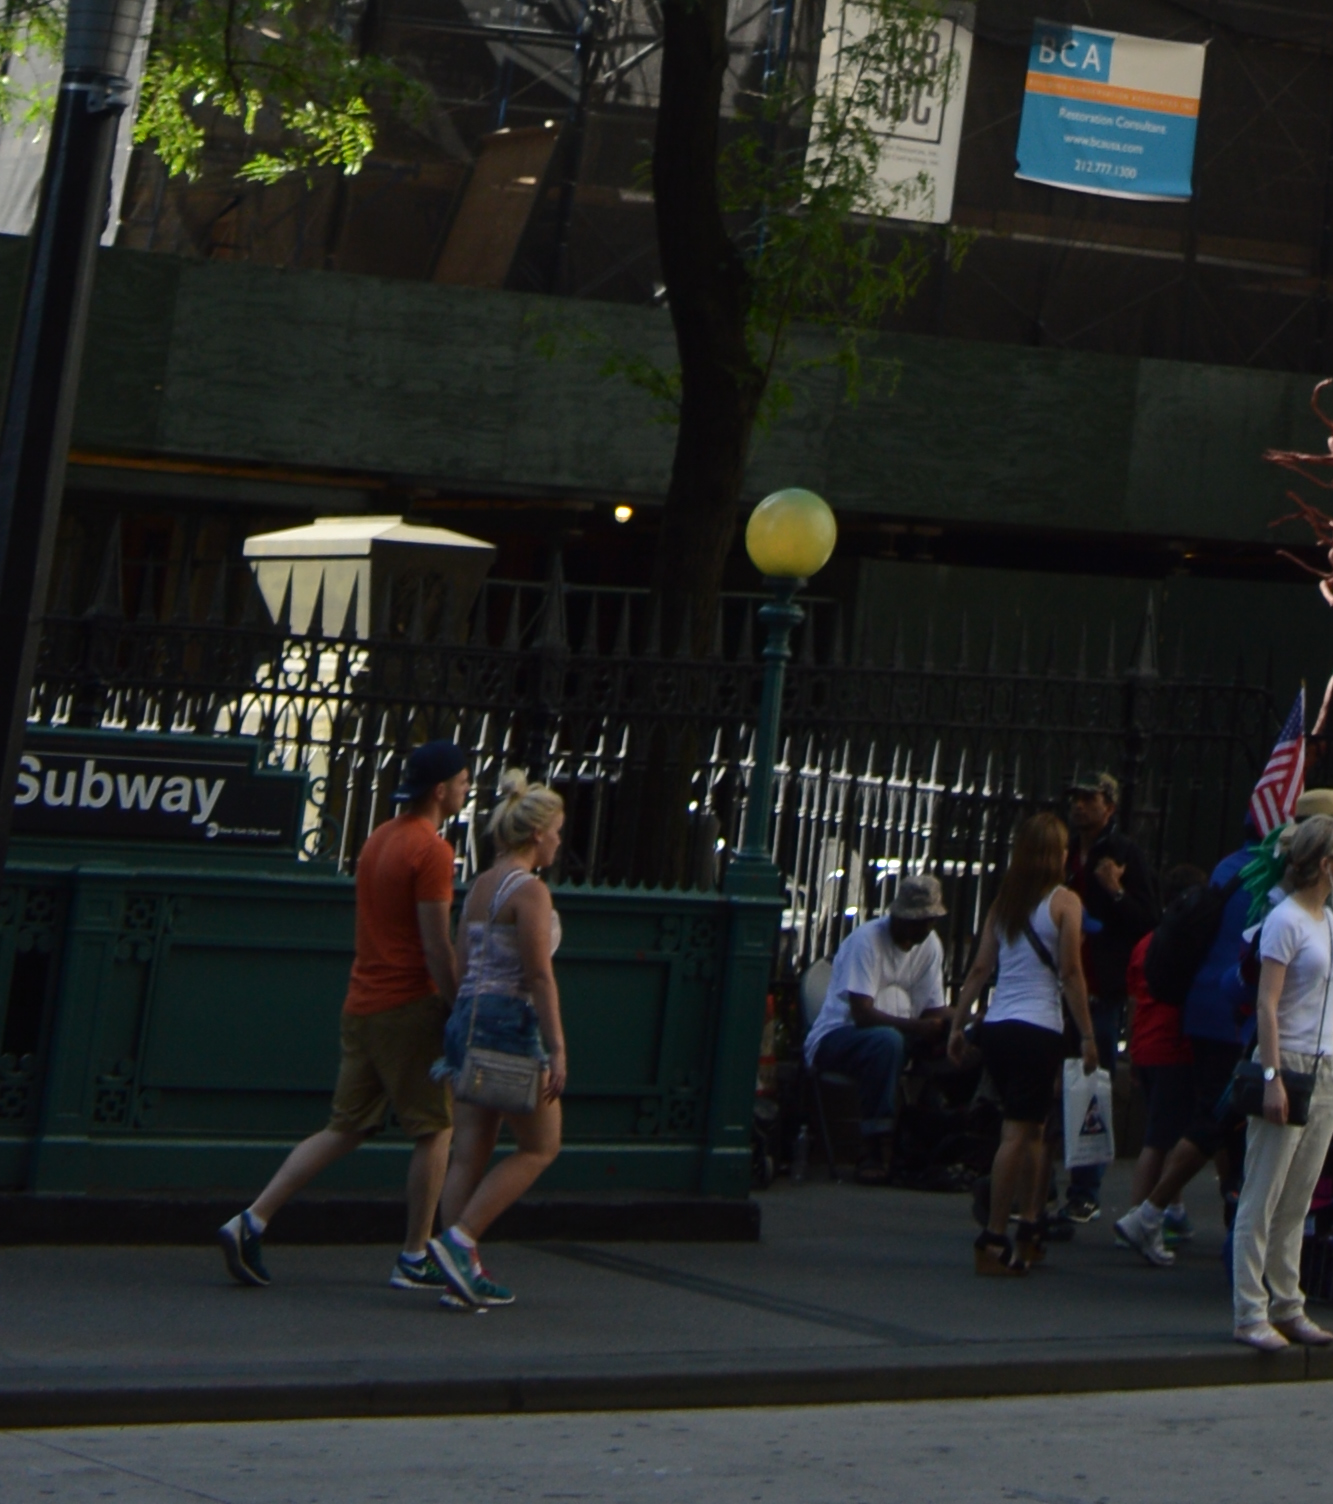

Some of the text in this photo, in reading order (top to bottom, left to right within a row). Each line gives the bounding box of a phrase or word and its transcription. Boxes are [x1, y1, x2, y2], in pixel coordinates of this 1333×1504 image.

[1038, 37, 1101, 72] BCA
[1058, 107, 1167, 135] Restoration Consultant
[14, 754, 226, 825] Subway
